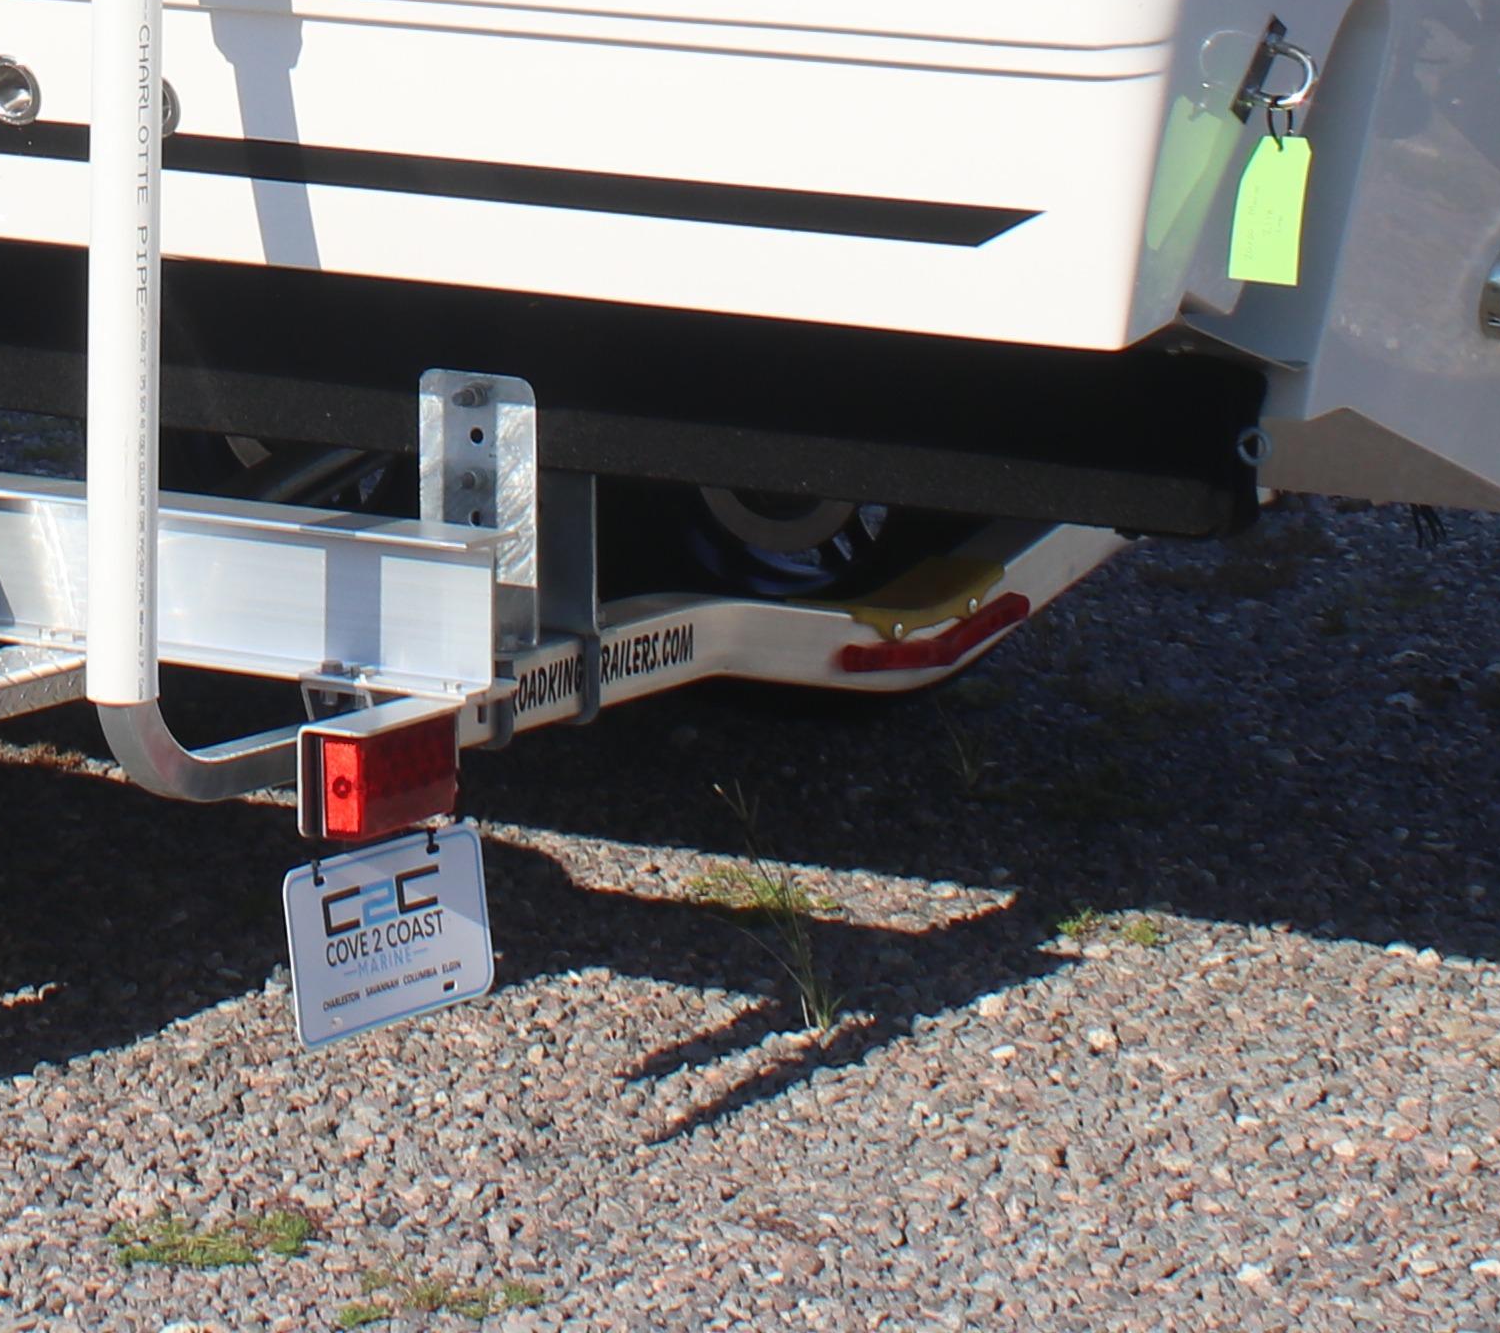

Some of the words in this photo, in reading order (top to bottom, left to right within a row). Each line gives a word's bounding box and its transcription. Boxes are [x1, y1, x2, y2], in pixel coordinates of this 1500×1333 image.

[136, 24, 151, 206] CHARLOTTE
[135, 224, 149, 307] PIPE
[321, 864, 439, 937] C2C
[326, 933, 369, 967] COVE
[372, 929, 383, 952] 2
[386, 910, 443, 948] COAST
[358, 948, 413, 976] MARINE
[322, 992, 361, 1012] CHARLESTON
[365, 979, 400, 997] SAVANNAH
[403, 966, 437, 986] COLUMBIA
[441, 961, 462, 974] ELGIN
